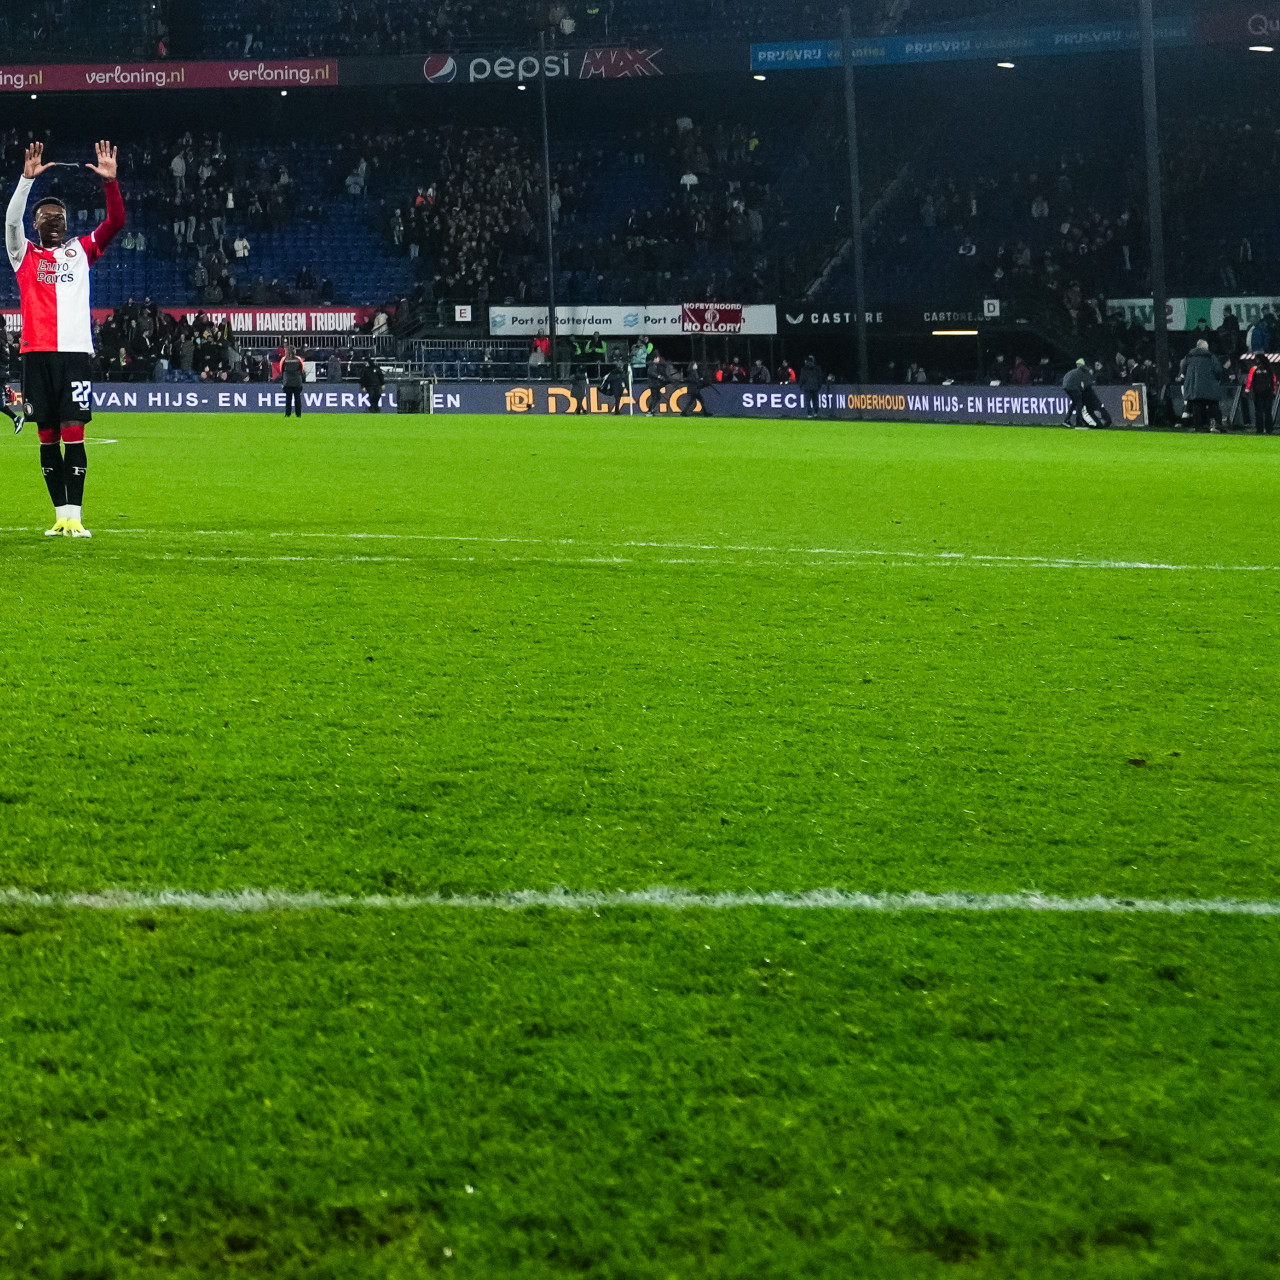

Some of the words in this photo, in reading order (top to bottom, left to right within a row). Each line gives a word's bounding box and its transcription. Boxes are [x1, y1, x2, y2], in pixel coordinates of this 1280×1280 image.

[469, 52, 570, 82] pepsi
[578, 48, 664, 80] MAX
[85, 66, 185, 87] verloning.nl
[228, 64, 330, 84] verloning.nl
[38, 260, 69, 272] Euro
[37, 272, 74, 284] Parcs
[460, 309, 467, 318] E
[987, 303, 996, 314] D
[230, 312, 252, 331] VAN
[256, 312, 306, 331] HANEGEM
[512, 316, 536, 325] Port
[538, 315, 548, 325] of
[644, 316, 666, 324] Port
[811, 313, 883, 324] CASTRE
[684, 323, 700, 332] NO
[703, 323, 741, 333] GLORY
[92, 392, 136, 407] VAN
[148, 392, 208, 407] HIJS-
[218, 392, 247, 407] EN
[836, 394, 846, 409] IN
[848, 395, 906, 410] ONDERHOUD
[907, 395, 930, 411] VAN
[933, 396, 963, 412] HIJS-
[967, 397, 983, 413] EN
